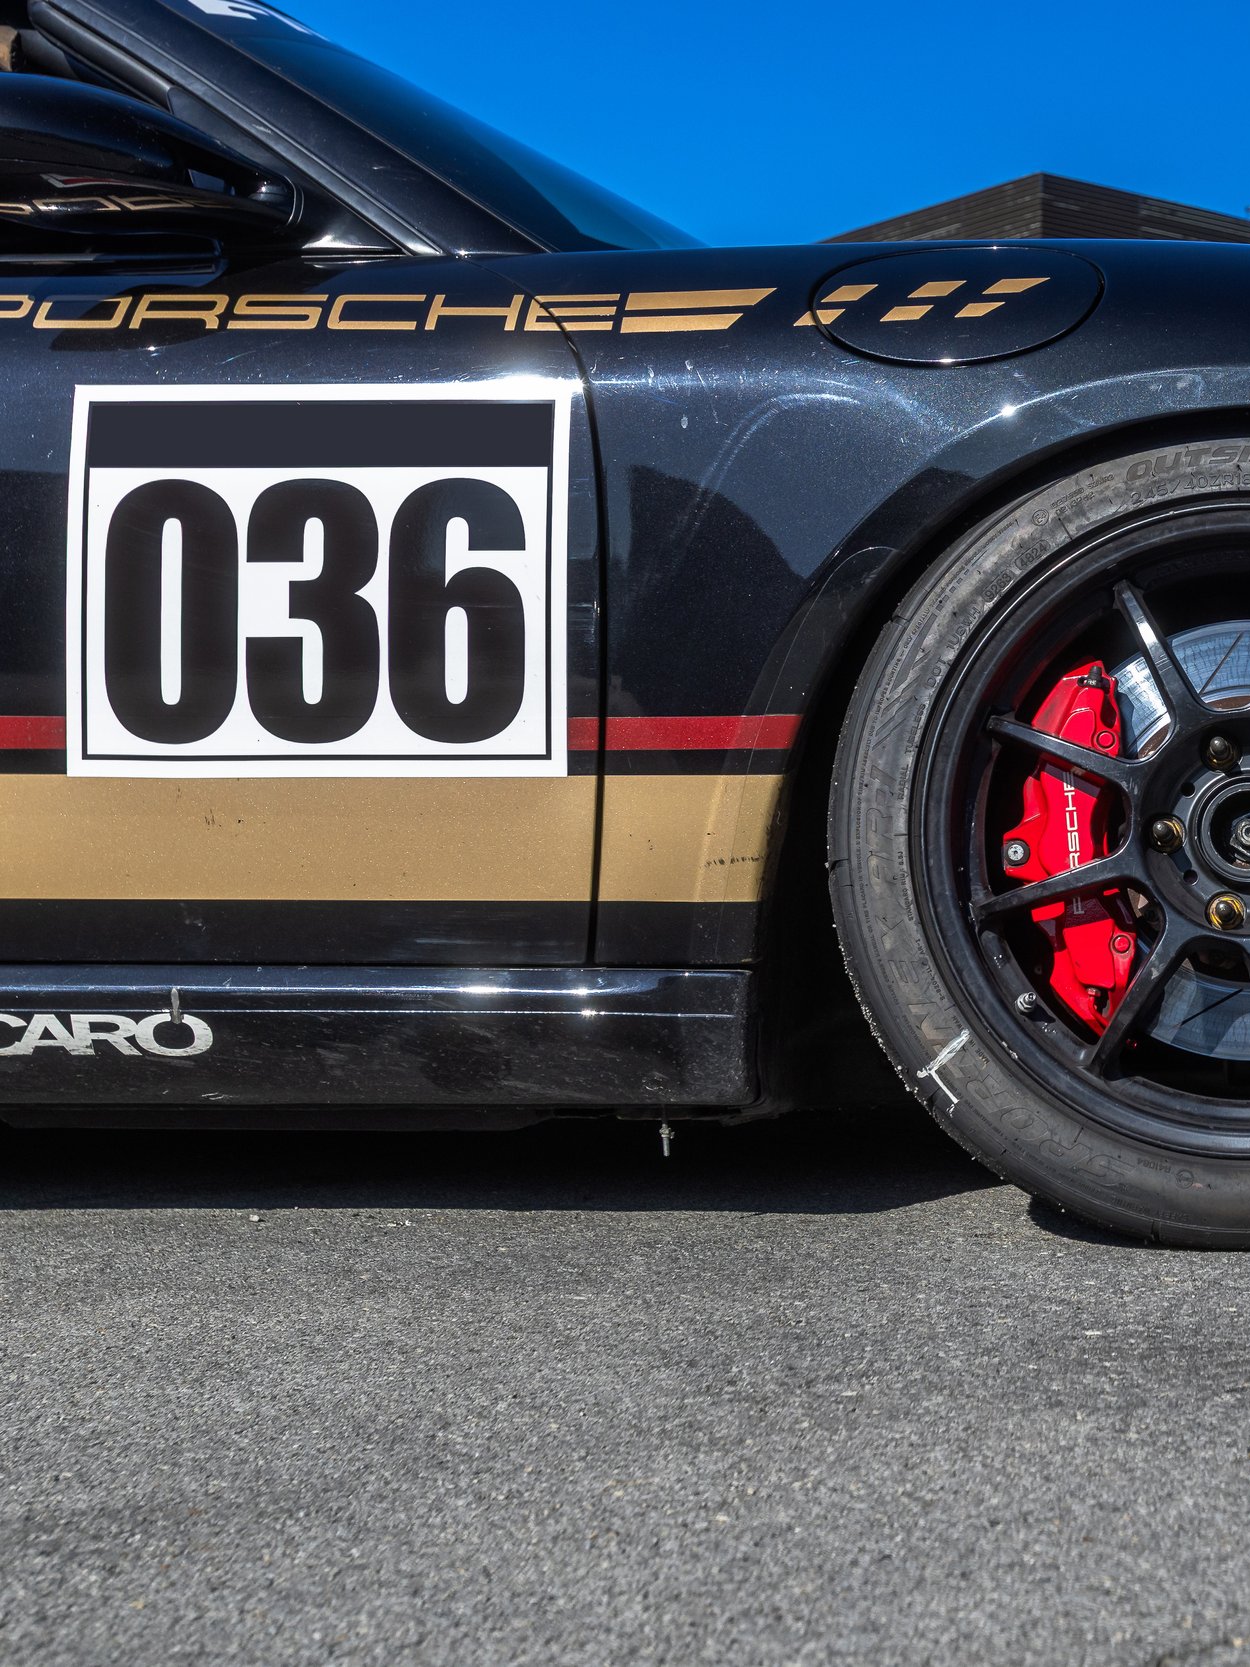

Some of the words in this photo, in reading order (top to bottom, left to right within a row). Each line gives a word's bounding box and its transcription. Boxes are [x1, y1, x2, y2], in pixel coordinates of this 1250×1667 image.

[105, 477, 526, 745] 036
[982, 571, 1011, 601] 9263
[897, 764, 907, 800] RADIAL
[904, 703, 926, 754] TUBELESS
[1062, 772, 1085, 915] PRSCHE
[874, 914, 1135, 1187] SPORTNEX
[975, 1048, 990, 1065] MADE
